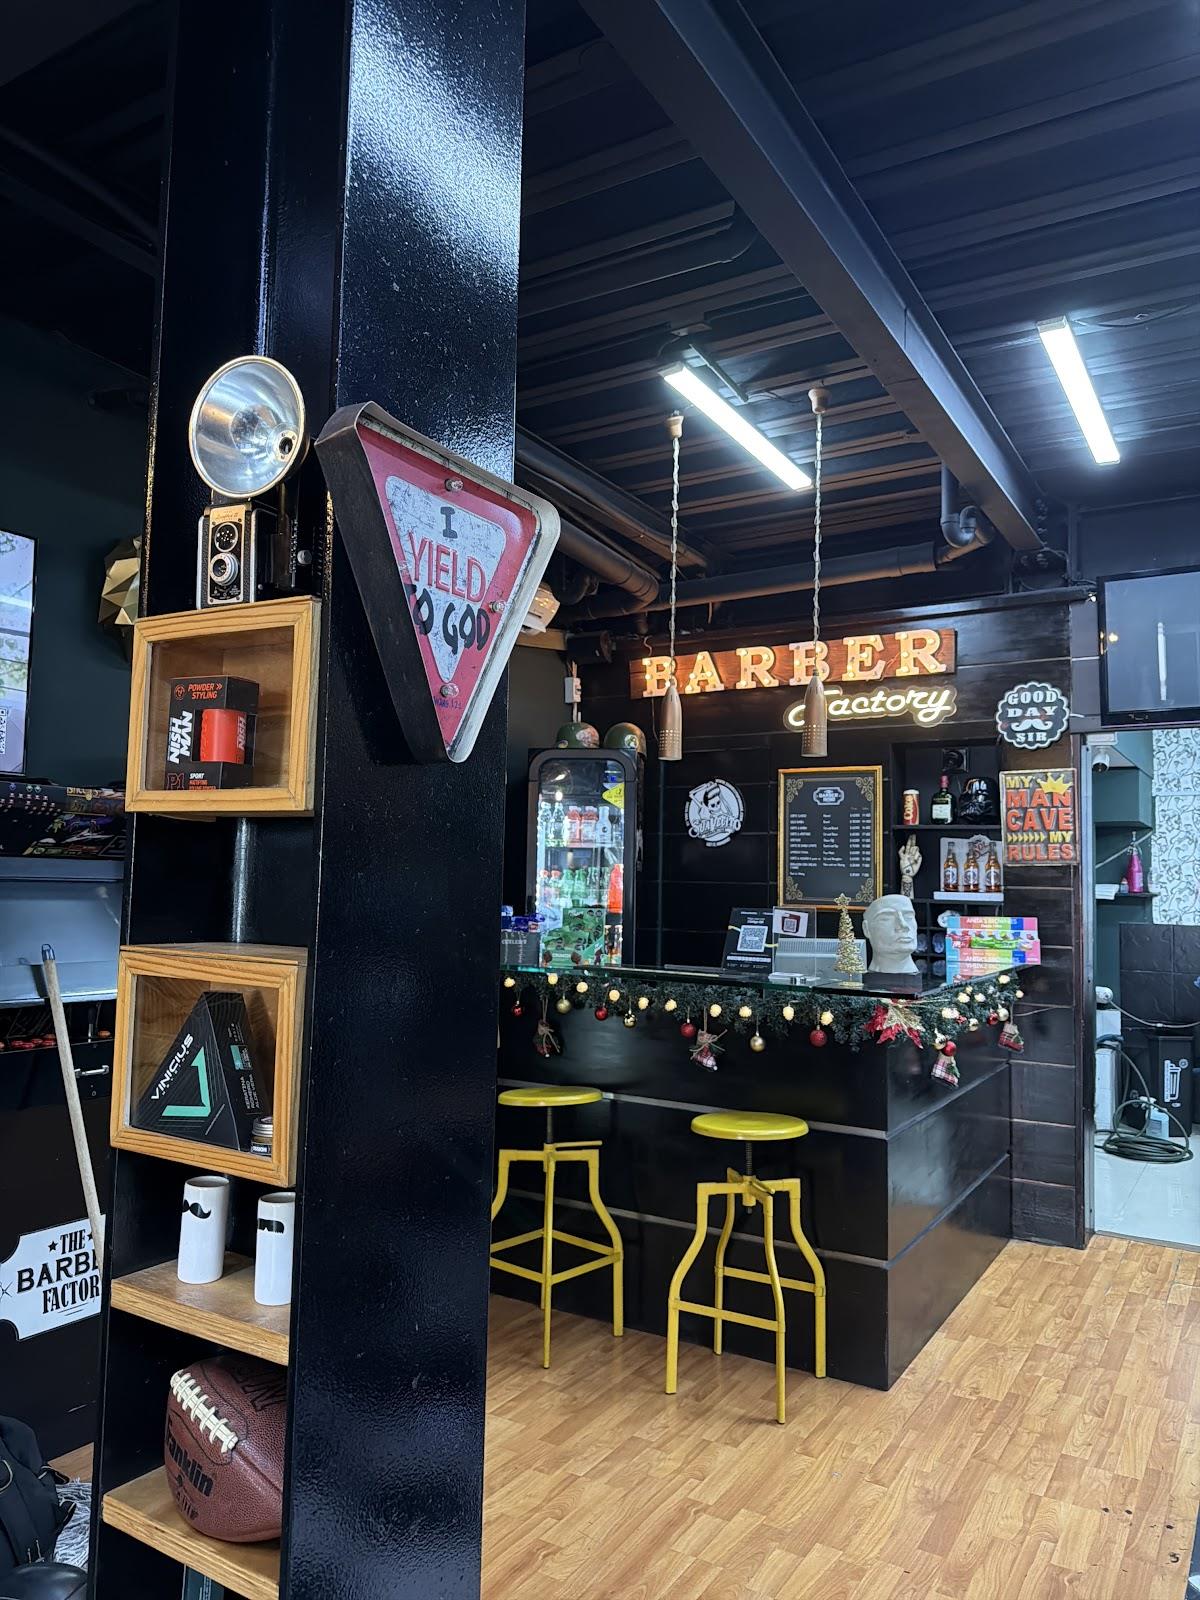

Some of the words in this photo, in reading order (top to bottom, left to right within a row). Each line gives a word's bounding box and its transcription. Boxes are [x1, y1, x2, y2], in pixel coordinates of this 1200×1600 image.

[440, 506, 458, 539] I
[408, 530, 487, 603] YIELD
[442, 602, 491, 655] GOD
[642, 628, 948, 698] BARBER
[187, 683, 215, 692] POWDER
[191, 690, 218, 699] STYLING
[1007, 690, 1058, 705] GOOD
[1007, 705, 1058, 718] DAY
[1015, 731, 1047, 743] SIR
[1006, 775, 1033, 789] MY
[1006, 788, 1072, 808] MAN
[1007, 808, 1074, 831] CAVE
[1049, 832, 1074, 843] MY
[1007, 844, 1074, 861] RULES
[150, 1033, 194, 1100] VINICIUS
[60, 1229, 86, 1255] THE
[43, 1274, 100, 1315] FACTOR
